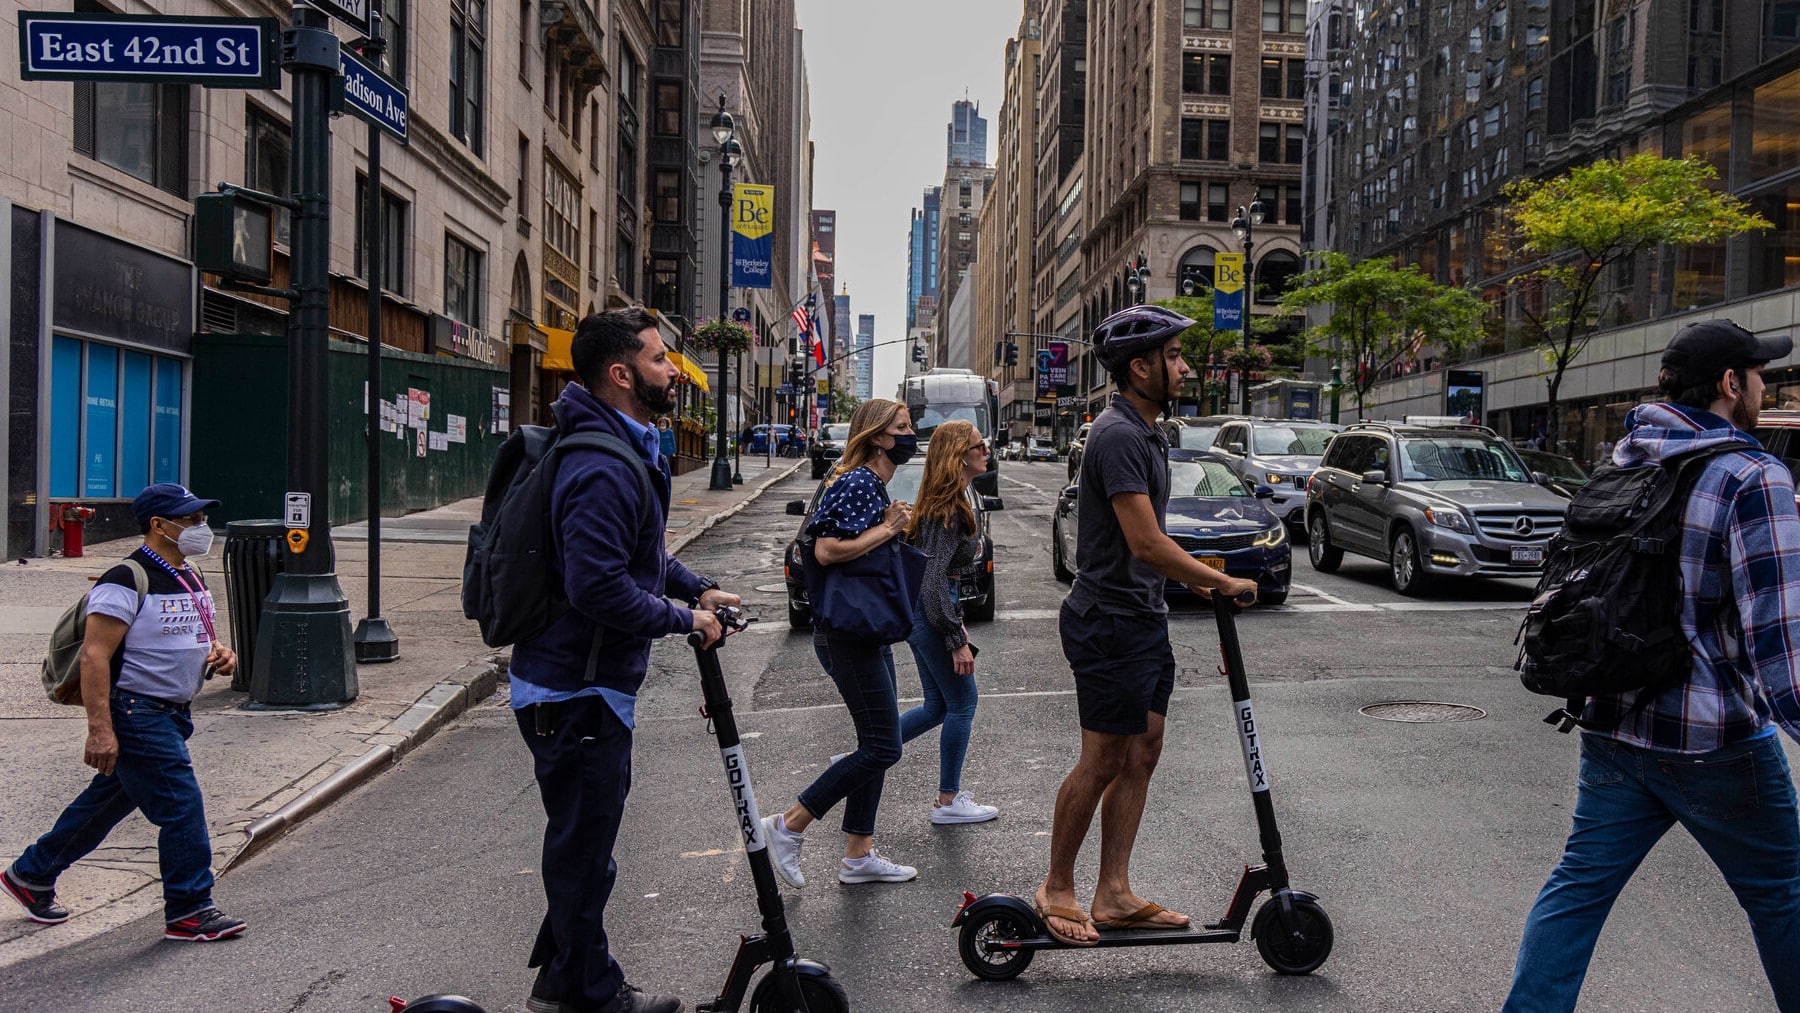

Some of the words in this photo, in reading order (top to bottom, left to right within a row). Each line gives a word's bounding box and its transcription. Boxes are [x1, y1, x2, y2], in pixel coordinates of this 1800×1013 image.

[39, 33, 114, 63] East
[124, 36, 205, 65] 42nd
[216, 38, 250, 66] St
[385, 94, 405, 127] Ave
[737, 199, 768, 224] Be
[742, 259, 768, 267] Berkeley
[743, 266, 767, 275] College
[1218, 264, 1240, 282] Be
[163, 625, 193, 635] BORN
[1241, 707, 1265, 786] GOTRAX
[725, 753, 756, 845] GOTRAX
